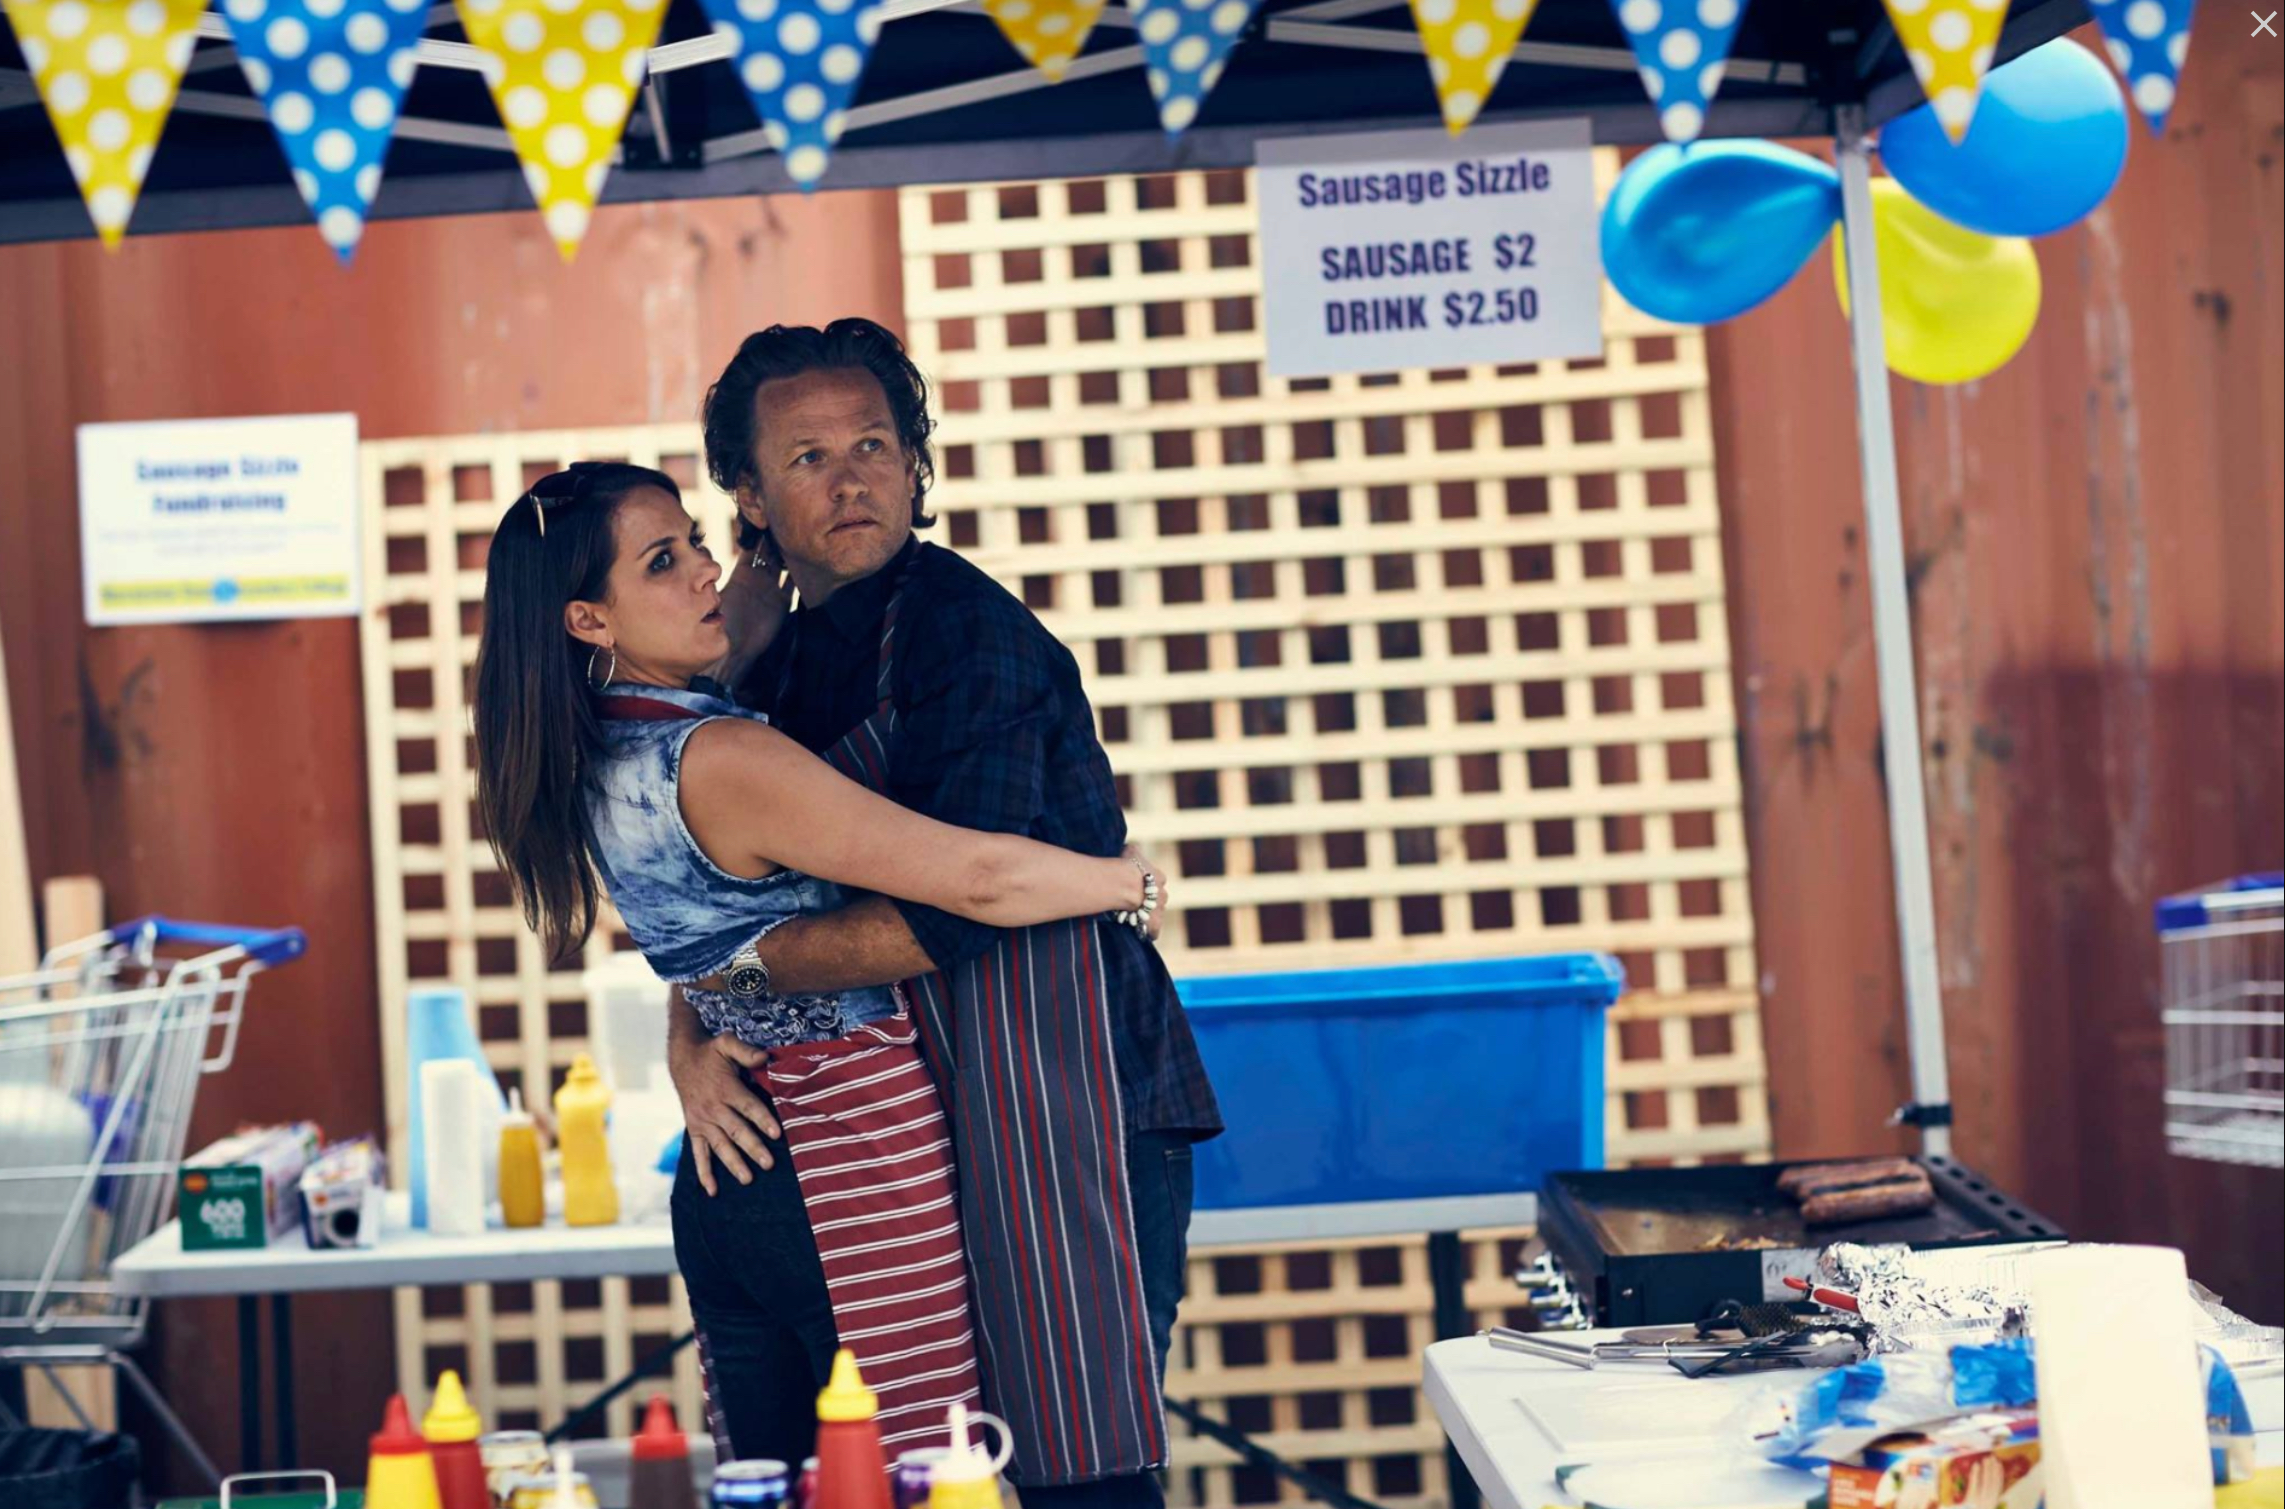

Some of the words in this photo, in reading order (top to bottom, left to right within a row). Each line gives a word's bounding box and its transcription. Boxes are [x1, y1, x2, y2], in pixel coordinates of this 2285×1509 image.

[1298, 169, 1447, 207] Sausage
[1455, 158, 1550, 197] Sizzle
[1321, 238, 1471, 282] SAUSAGE
[1493, 232, 1536, 272] $2
[1325, 295, 1429, 336] DRINK
[1443, 286, 1538, 329] $2.50
